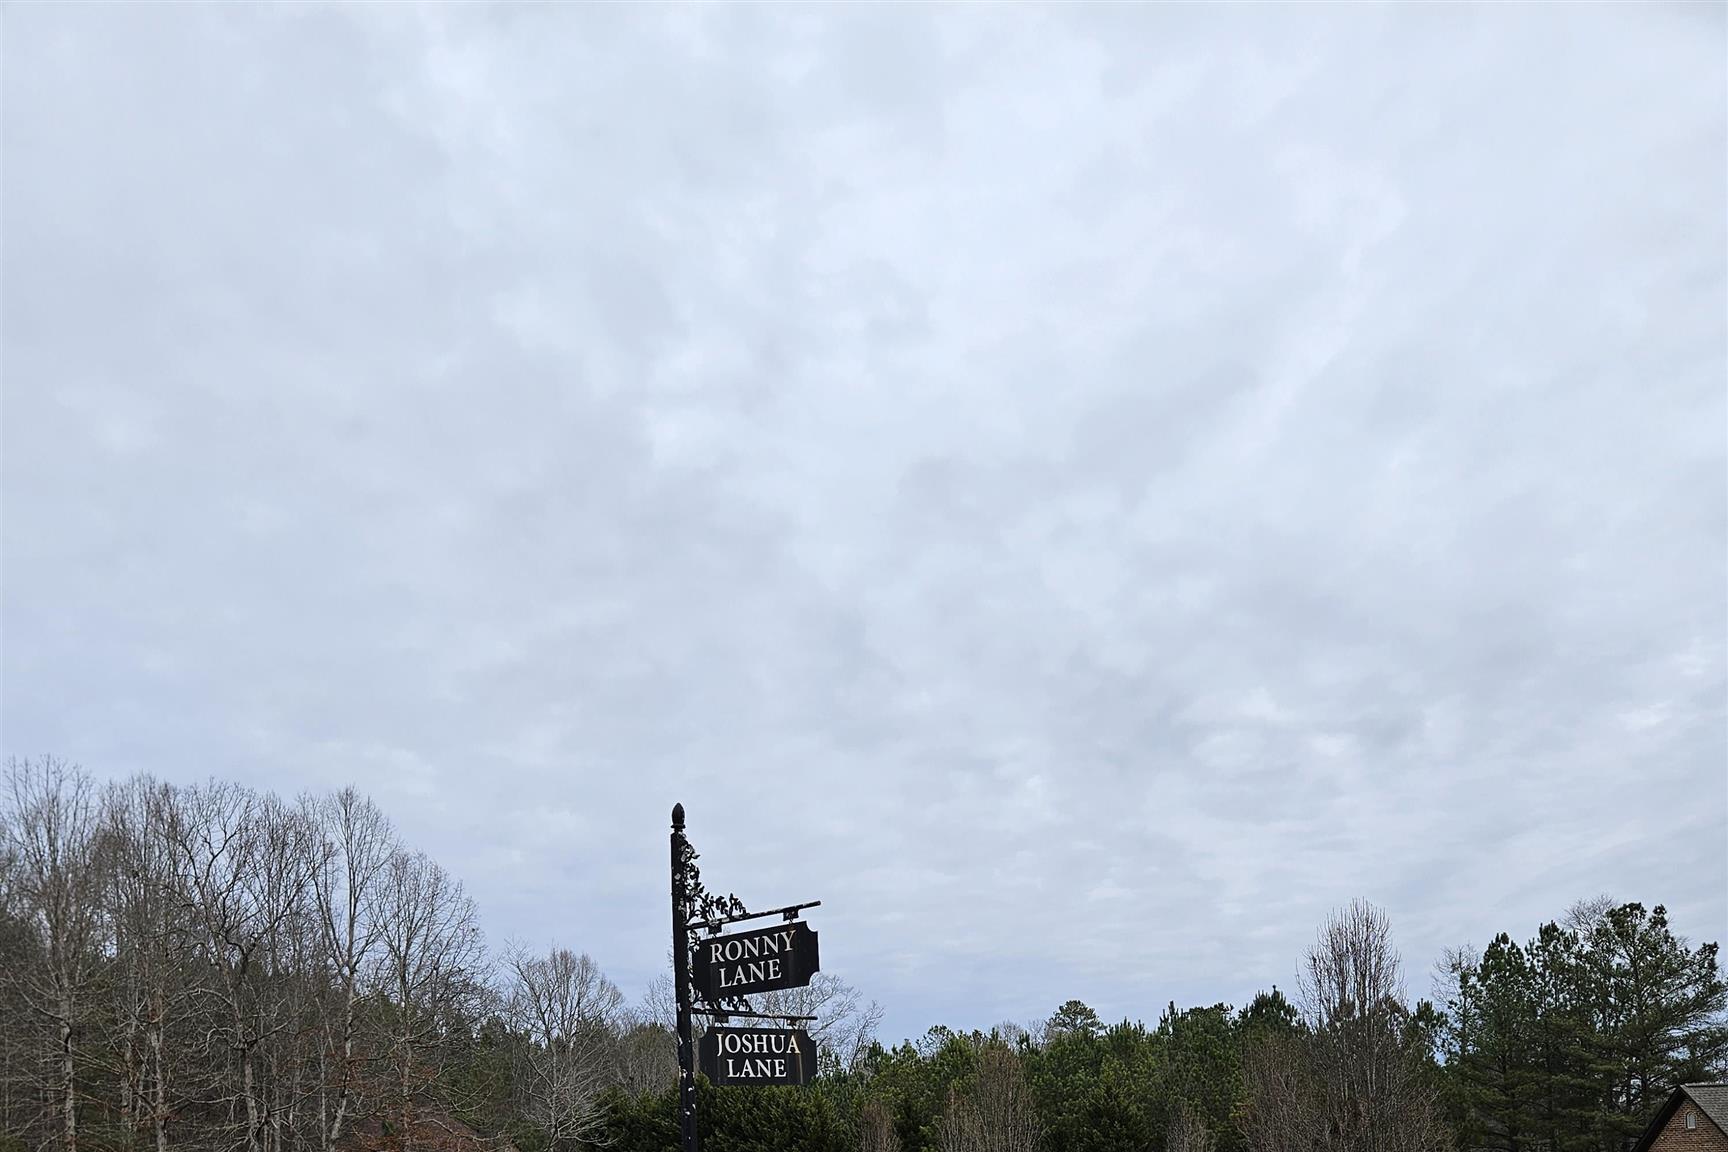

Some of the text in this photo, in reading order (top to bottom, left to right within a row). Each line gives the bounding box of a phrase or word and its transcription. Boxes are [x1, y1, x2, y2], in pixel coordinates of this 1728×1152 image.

[710, 930, 796, 964] RONNY
[719, 959, 782, 988] LANE
[716, 1033, 801, 1056] JOSHUA
[727, 1059, 787, 1078] LANE
